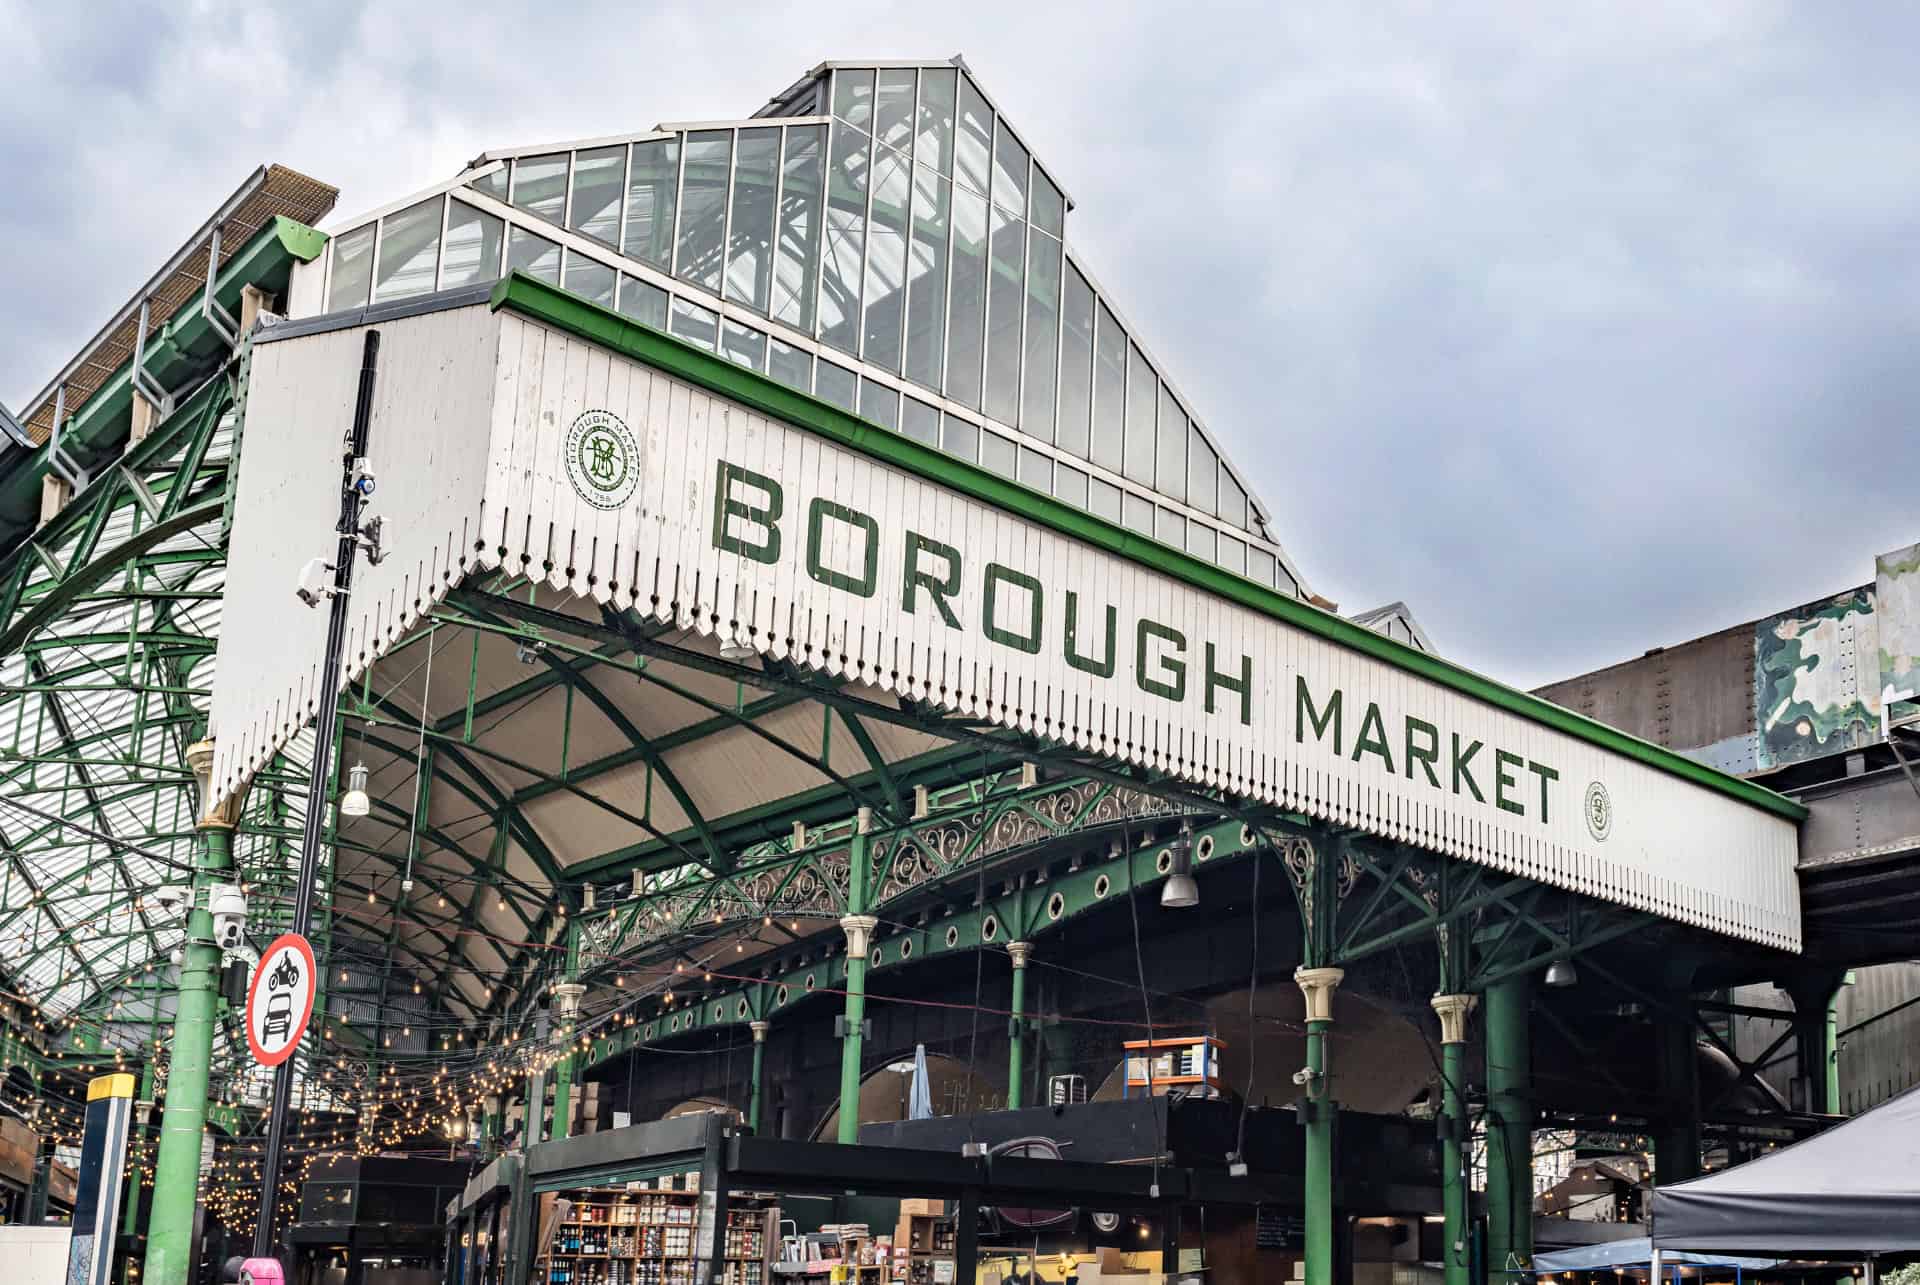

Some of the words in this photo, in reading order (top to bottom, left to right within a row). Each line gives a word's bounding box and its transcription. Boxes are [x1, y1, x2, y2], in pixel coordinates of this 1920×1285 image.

[569, 415, 609, 464] BOROUGH
[614, 424, 636, 484] MARKET
[712, 458, 1252, 726] BOROUGH
[1296, 674, 1559, 824] MARKET
